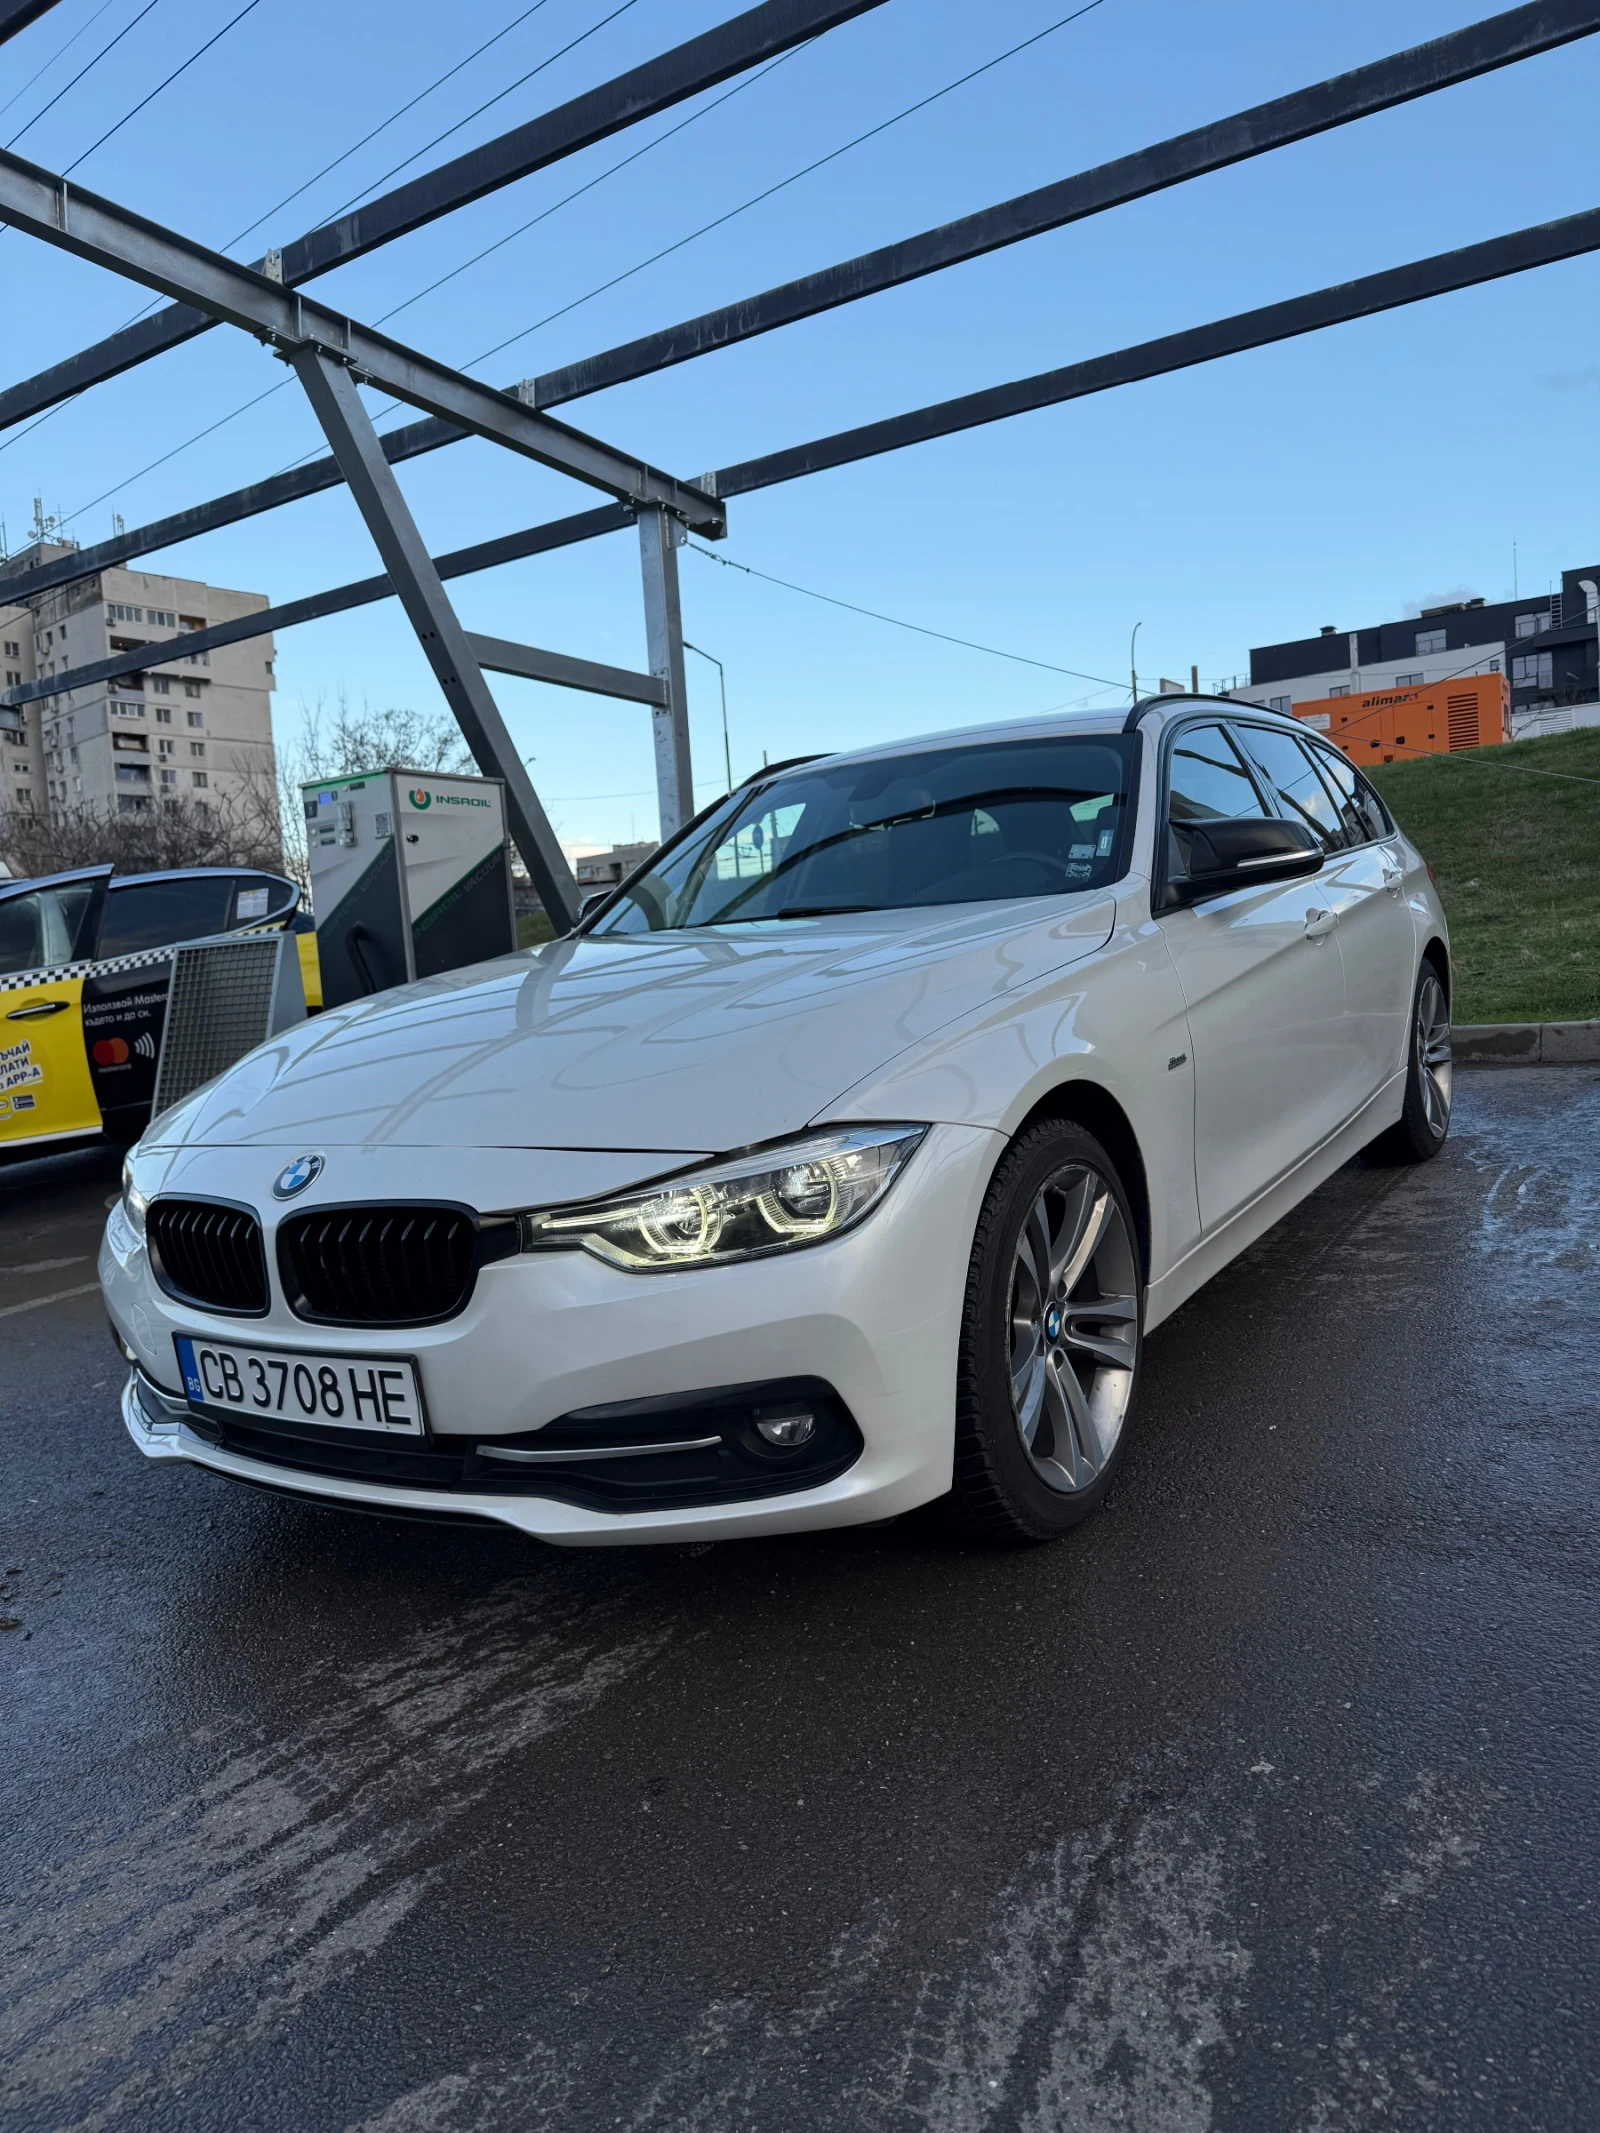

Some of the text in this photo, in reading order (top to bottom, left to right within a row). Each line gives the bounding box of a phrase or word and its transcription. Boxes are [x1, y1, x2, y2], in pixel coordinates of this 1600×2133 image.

[462, 852, 502, 892] VACUUM
[83, 997, 133, 1014] Използвай
[85, 1014, 115, 1027] където
[116, 1014, 122, 1022] и
[187, 1376, 201, 1392] BG
[200, 1348, 411, 1426] CB 3708 HE
